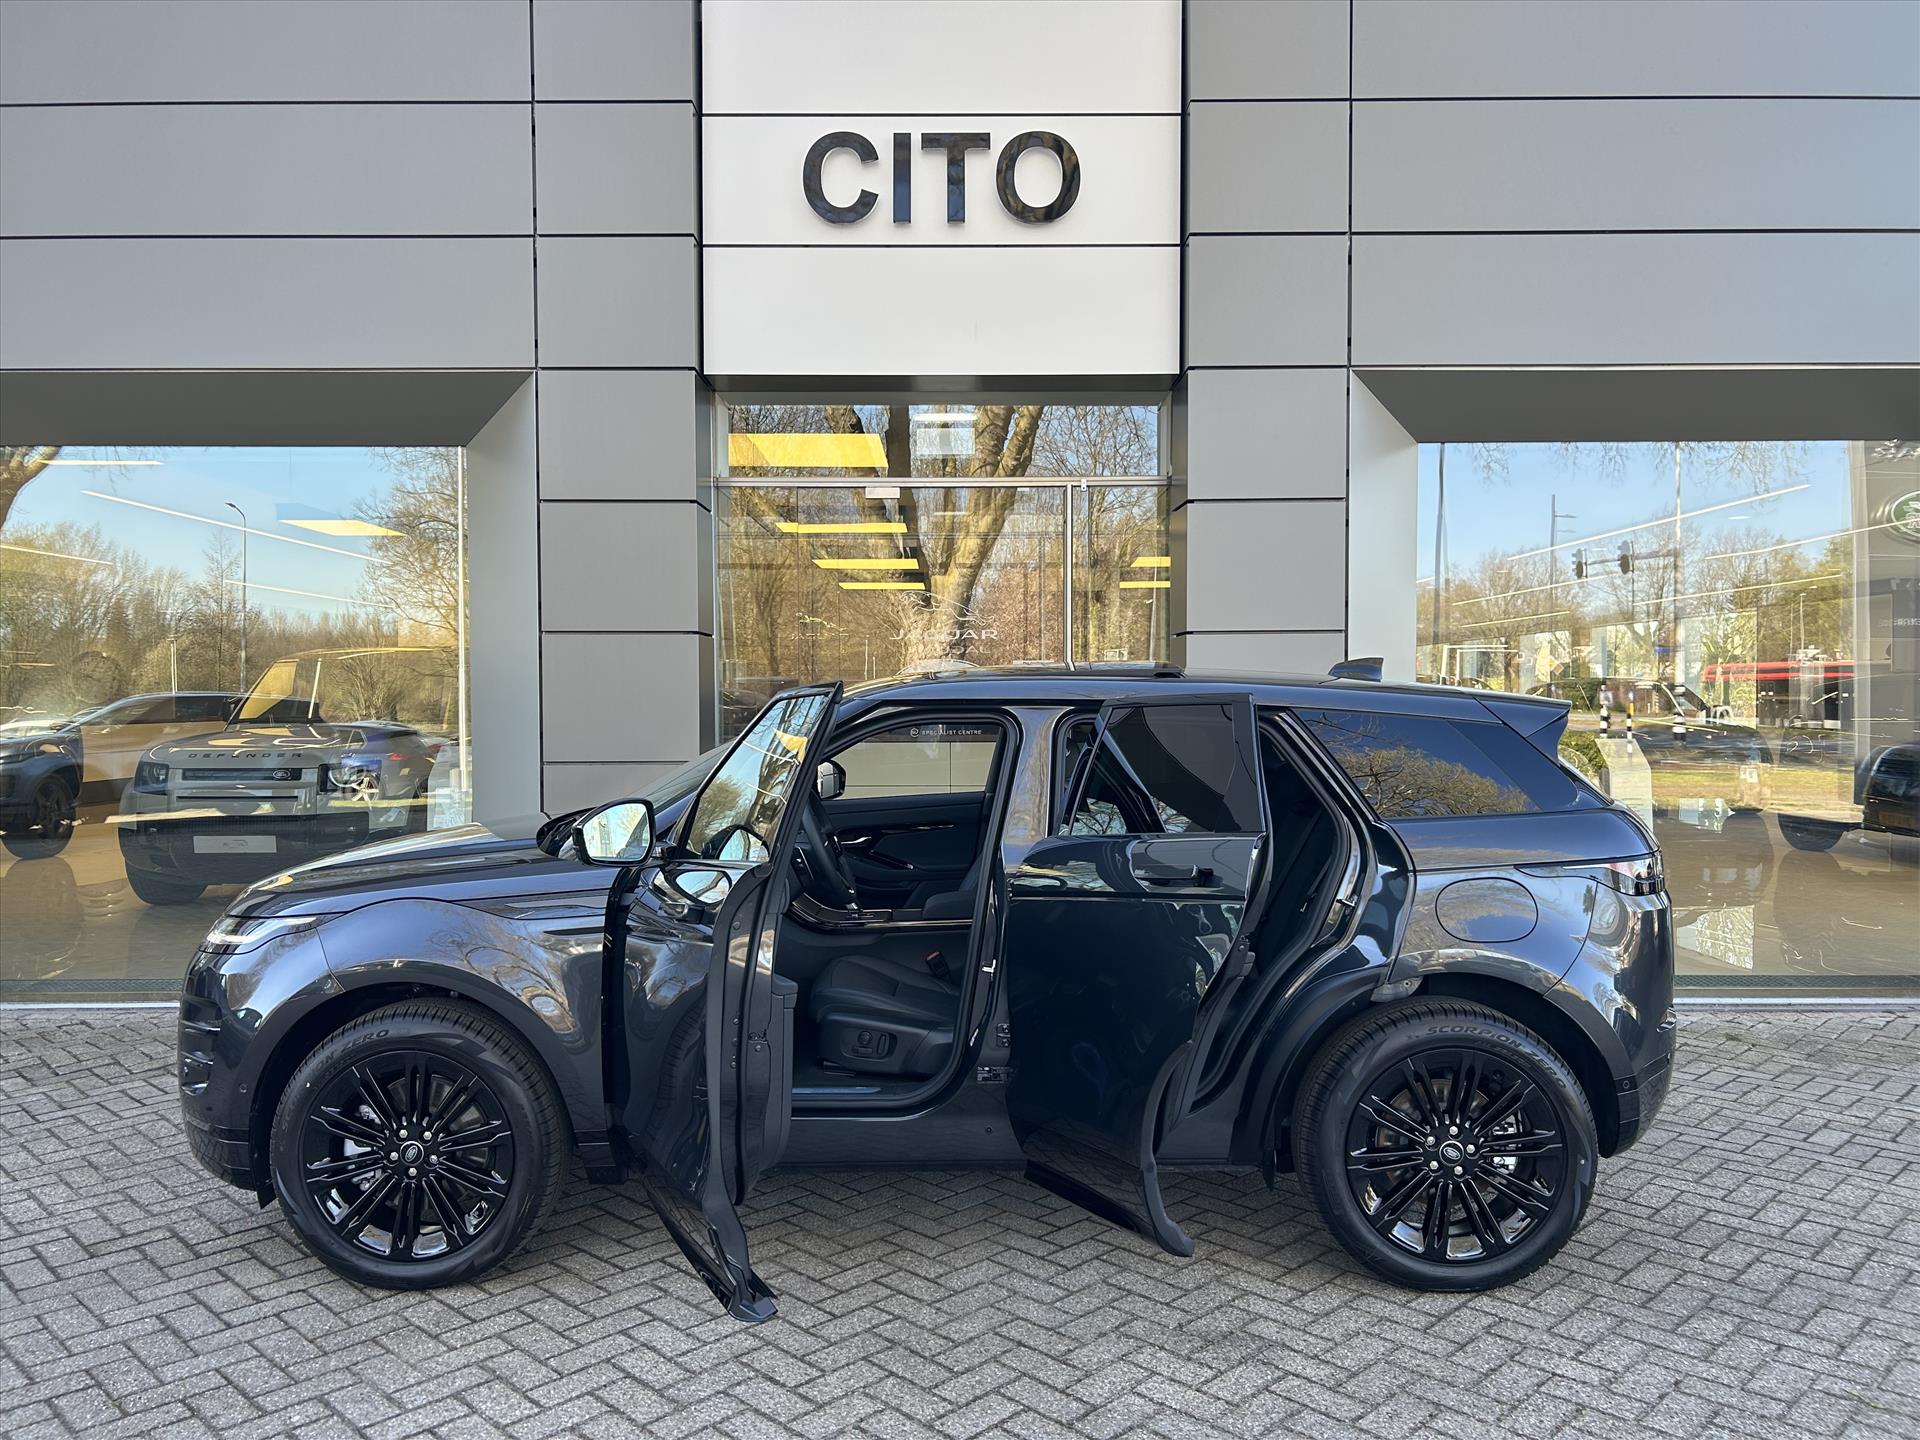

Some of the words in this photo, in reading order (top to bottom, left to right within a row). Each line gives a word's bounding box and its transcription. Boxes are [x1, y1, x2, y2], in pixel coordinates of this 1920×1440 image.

[803, 131, 1081, 224] CITO
[340, 1028, 389, 1054] ZERO
[1425, 1025, 1522, 1049] SCORPION
[1527, 1050, 1567, 1089] ZERO
